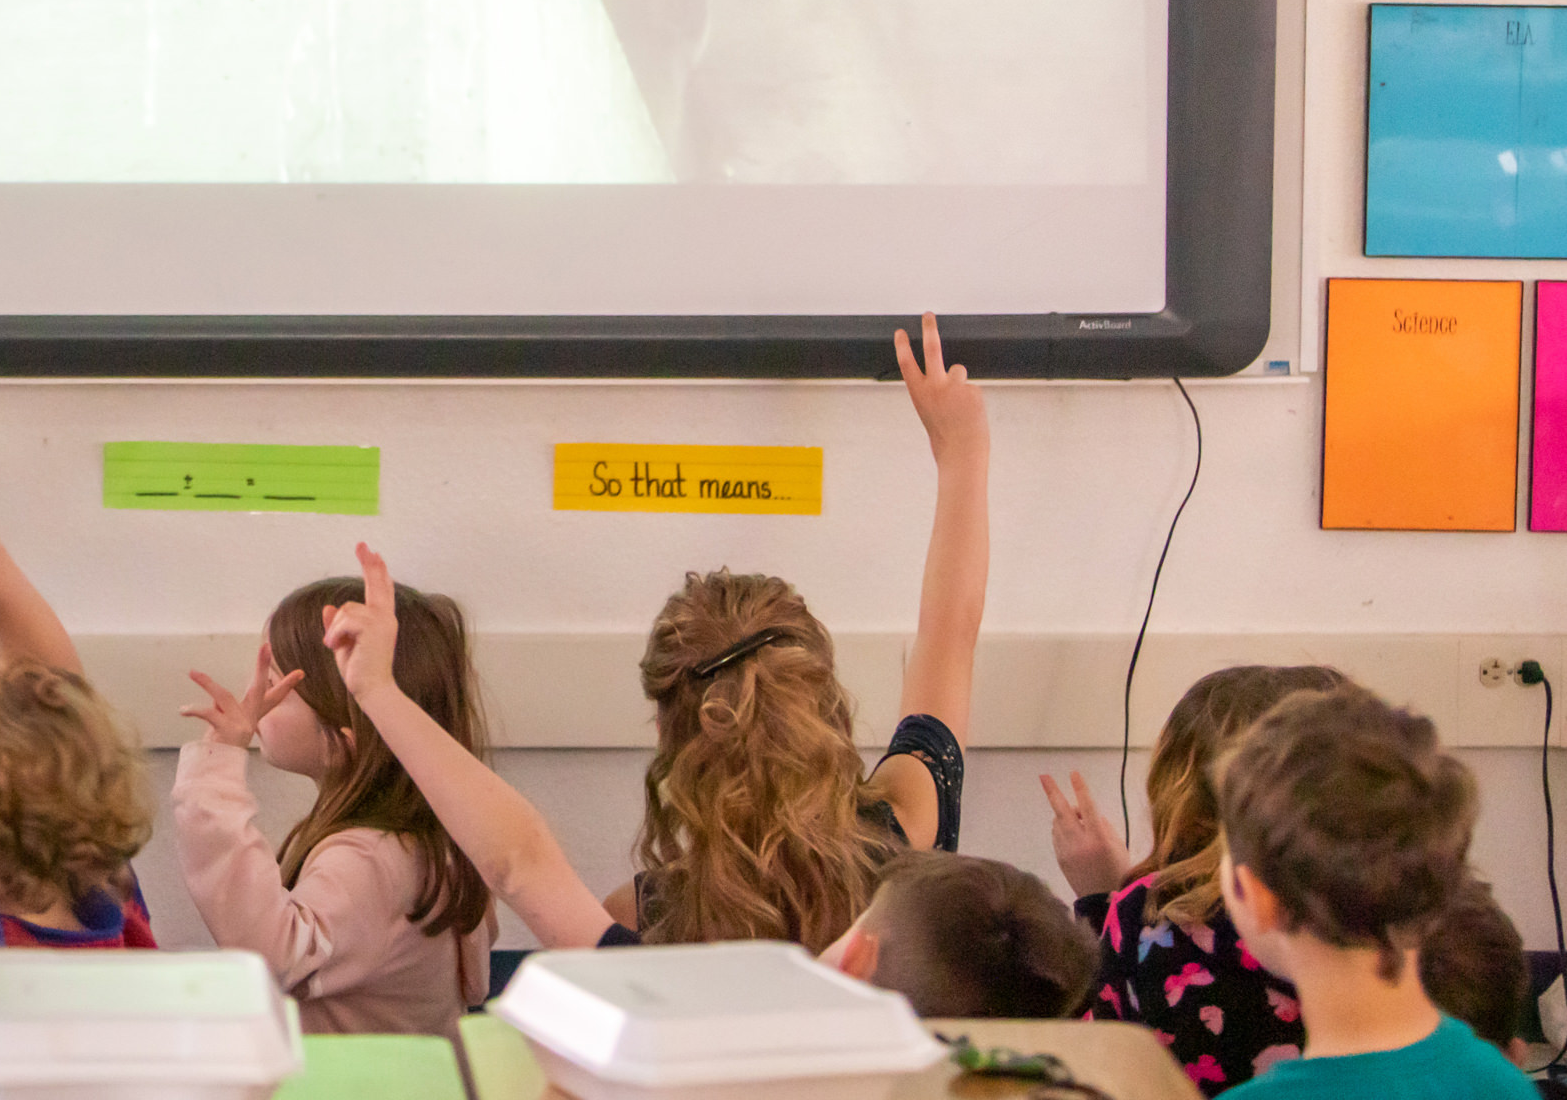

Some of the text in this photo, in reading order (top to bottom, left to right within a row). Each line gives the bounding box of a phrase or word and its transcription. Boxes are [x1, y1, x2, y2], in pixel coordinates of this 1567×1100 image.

[1079, 320, 1132, 330] ActivBoard
[1393, 309, 1458, 335] Science
[590, 461, 622, 497] So
[630, 461, 687, 498] that
